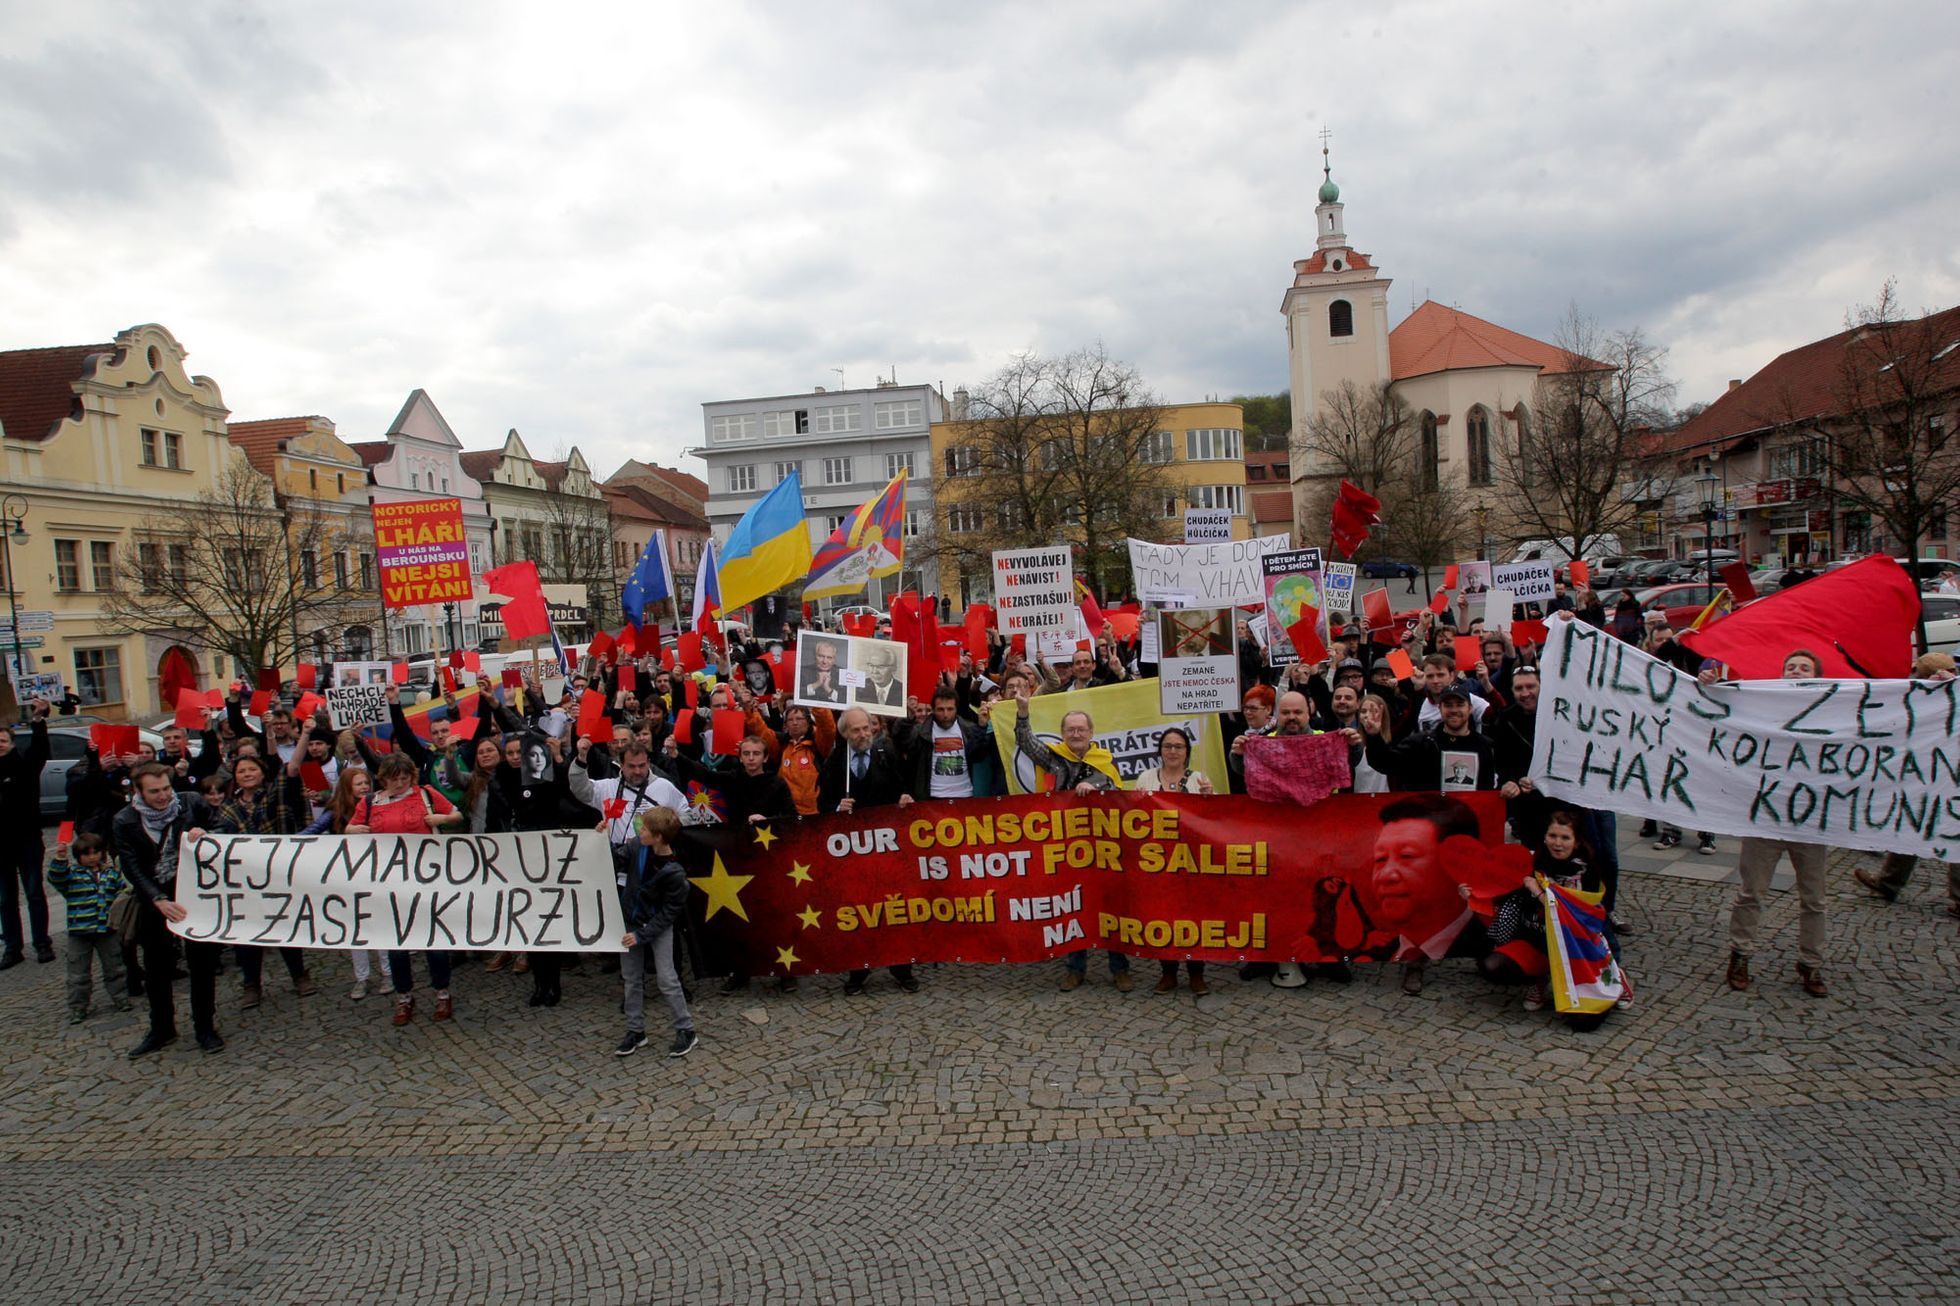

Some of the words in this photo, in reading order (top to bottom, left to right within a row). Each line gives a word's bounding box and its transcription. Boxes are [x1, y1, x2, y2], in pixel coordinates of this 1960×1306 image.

[375, 500, 459, 517] NOTORICKÝ
[376, 518, 413, 528] NEJEN
[1186, 513, 1230, 525] CHUDÁČEK
[377, 519, 464, 547] LHÁŘÍ
[382, 551, 465, 567] BEROUNSKU
[408, 546, 426, 554] NÁS
[1136, 544, 1191, 567] TADY
[1197, 545, 1221, 566] JE
[1232, 537, 1289, 563] DOMA
[1269, 555, 1296, 565] DĚTEM
[1297, 553, 1318, 562] JSTE
[997, 552, 1067, 570] NEVYVOLÁVEJ
[1269, 564, 1287, 573] PRO
[1288, 561, 1313, 571] SMÍCH
[390, 562, 461, 584] NEJSI
[1497, 567, 1550, 584] CHUDÁČEK
[386, 580, 469, 602] VÍTÁN!
[1199, 565, 1262, 600] V.HAV
[1499, 582, 1552, 597] LČIČKA
[999, 590, 1072, 608] NEZASTRAŠUJ!
[1274, 655, 1300, 663] VERONI
[1182, 666, 1216, 676] ZEMANE
[1163, 679, 1181, 688] JSTE
[1182, 678, 1209, 687] NEMOC
[1211, 676, 1236, 686] ČESKA
[1181, 691, 1193, 699] NA
[1195, 689, 1218, 698] HRAD
[1177, 700, 1224, 711] NEPATŘÍTE!
[1553, 697, 1671, 746] RUSKÝ
[1544, 738, 1698, 814] LHÁŘ
[826, 827, 900, 857] OUR
[908, 807, 1180, 848] CONSCIENCE
[194, 836, 319, 890] BEJT
[320, 835, 509, 885] MAGOR
[514, 828, 584, 885] UŽ
[918, 856, 949, 880] IS
[960, 850, 1032, 880] NOT
[1042, 840, 1124, 875] FOR
[1138, 841, 1269, 876] SALE!
[836, 889, 997, 932] SVĚDOMÍ
[1009, 884, 1083, 921] NENÍ
[184, 892, 246, 941] JE
[249, 891, 372, 946] ZASE
[1043, 918, 1086, 948] NA
[1098, 911, 1267, 949] PRODEJ!
